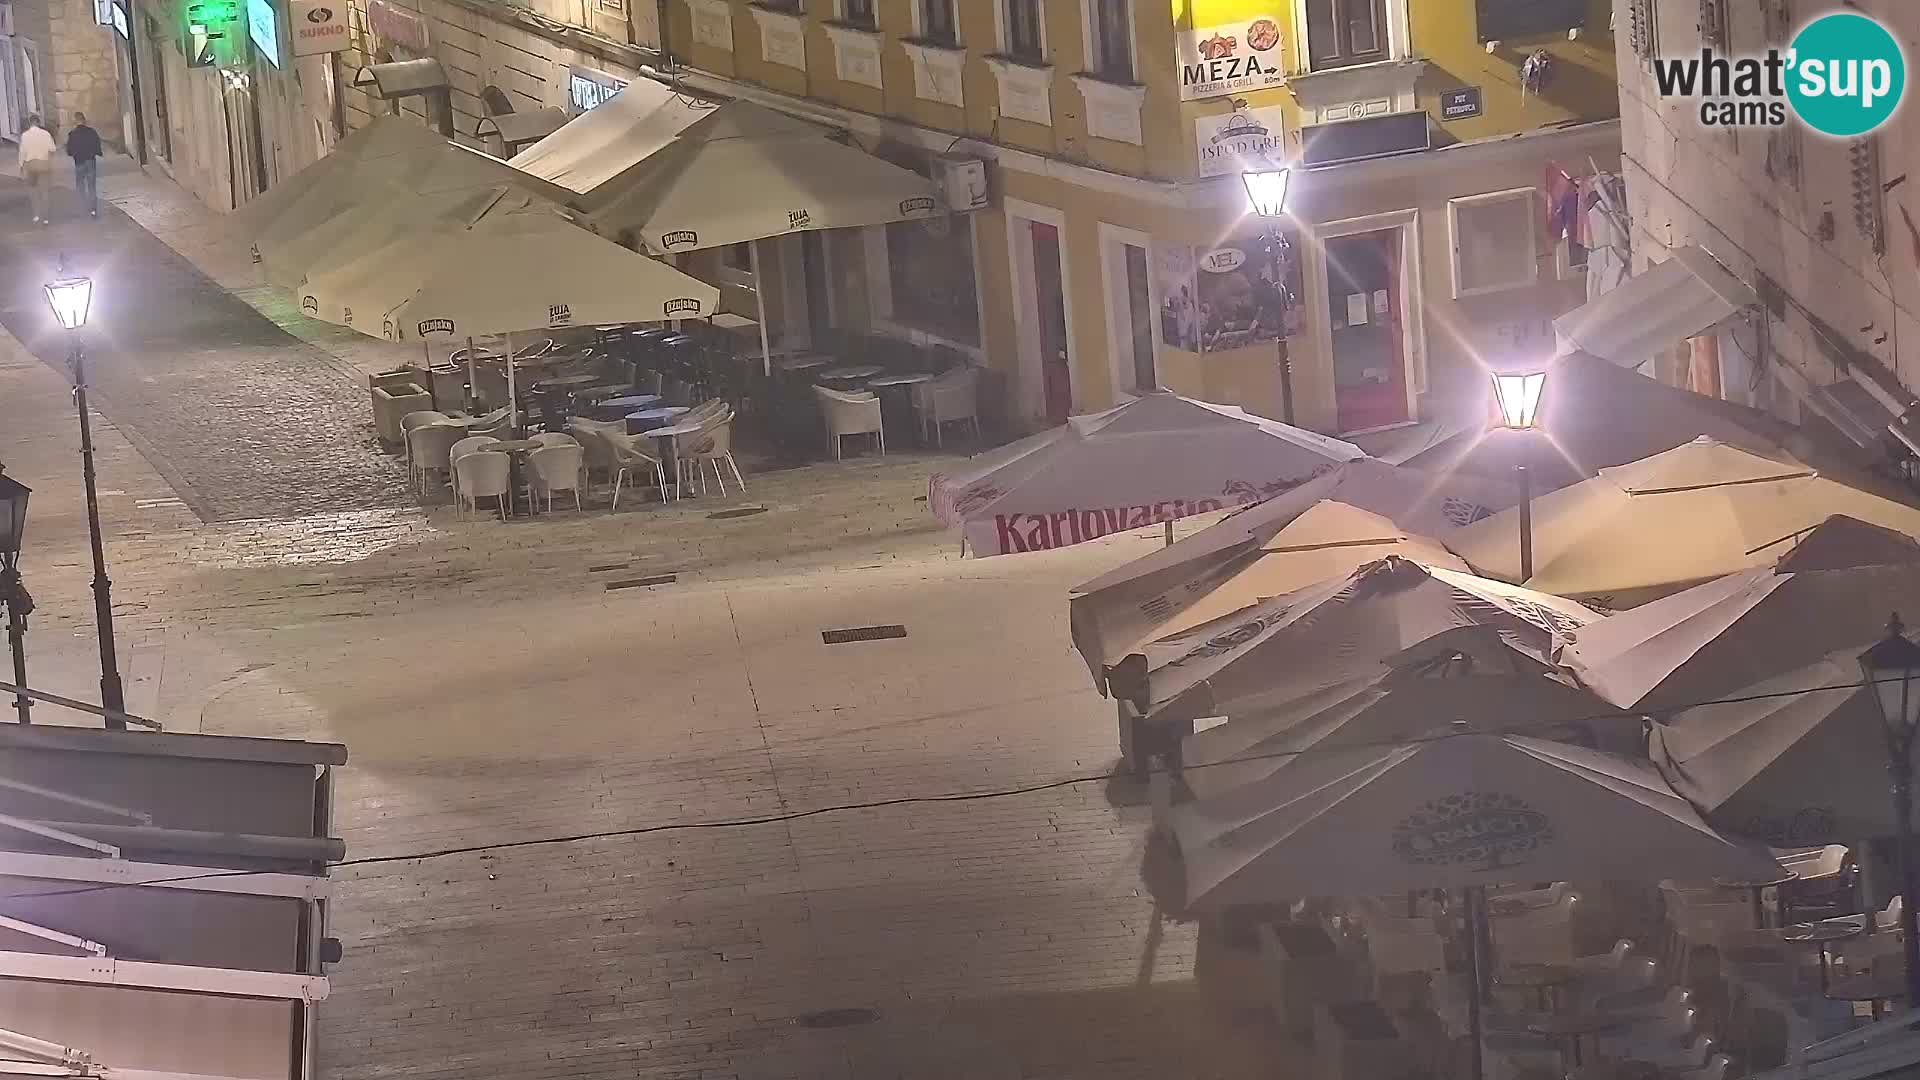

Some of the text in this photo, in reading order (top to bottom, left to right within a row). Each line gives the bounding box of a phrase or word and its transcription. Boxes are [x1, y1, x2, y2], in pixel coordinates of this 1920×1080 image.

[299, 24, 344, 39] SUKNO
[1184, 56, 1262, 86] MEZA
[1193, 78, 1254, 93] PIZZERIA & GRILL
[1202, 142, 1247, 159] ISPOD
